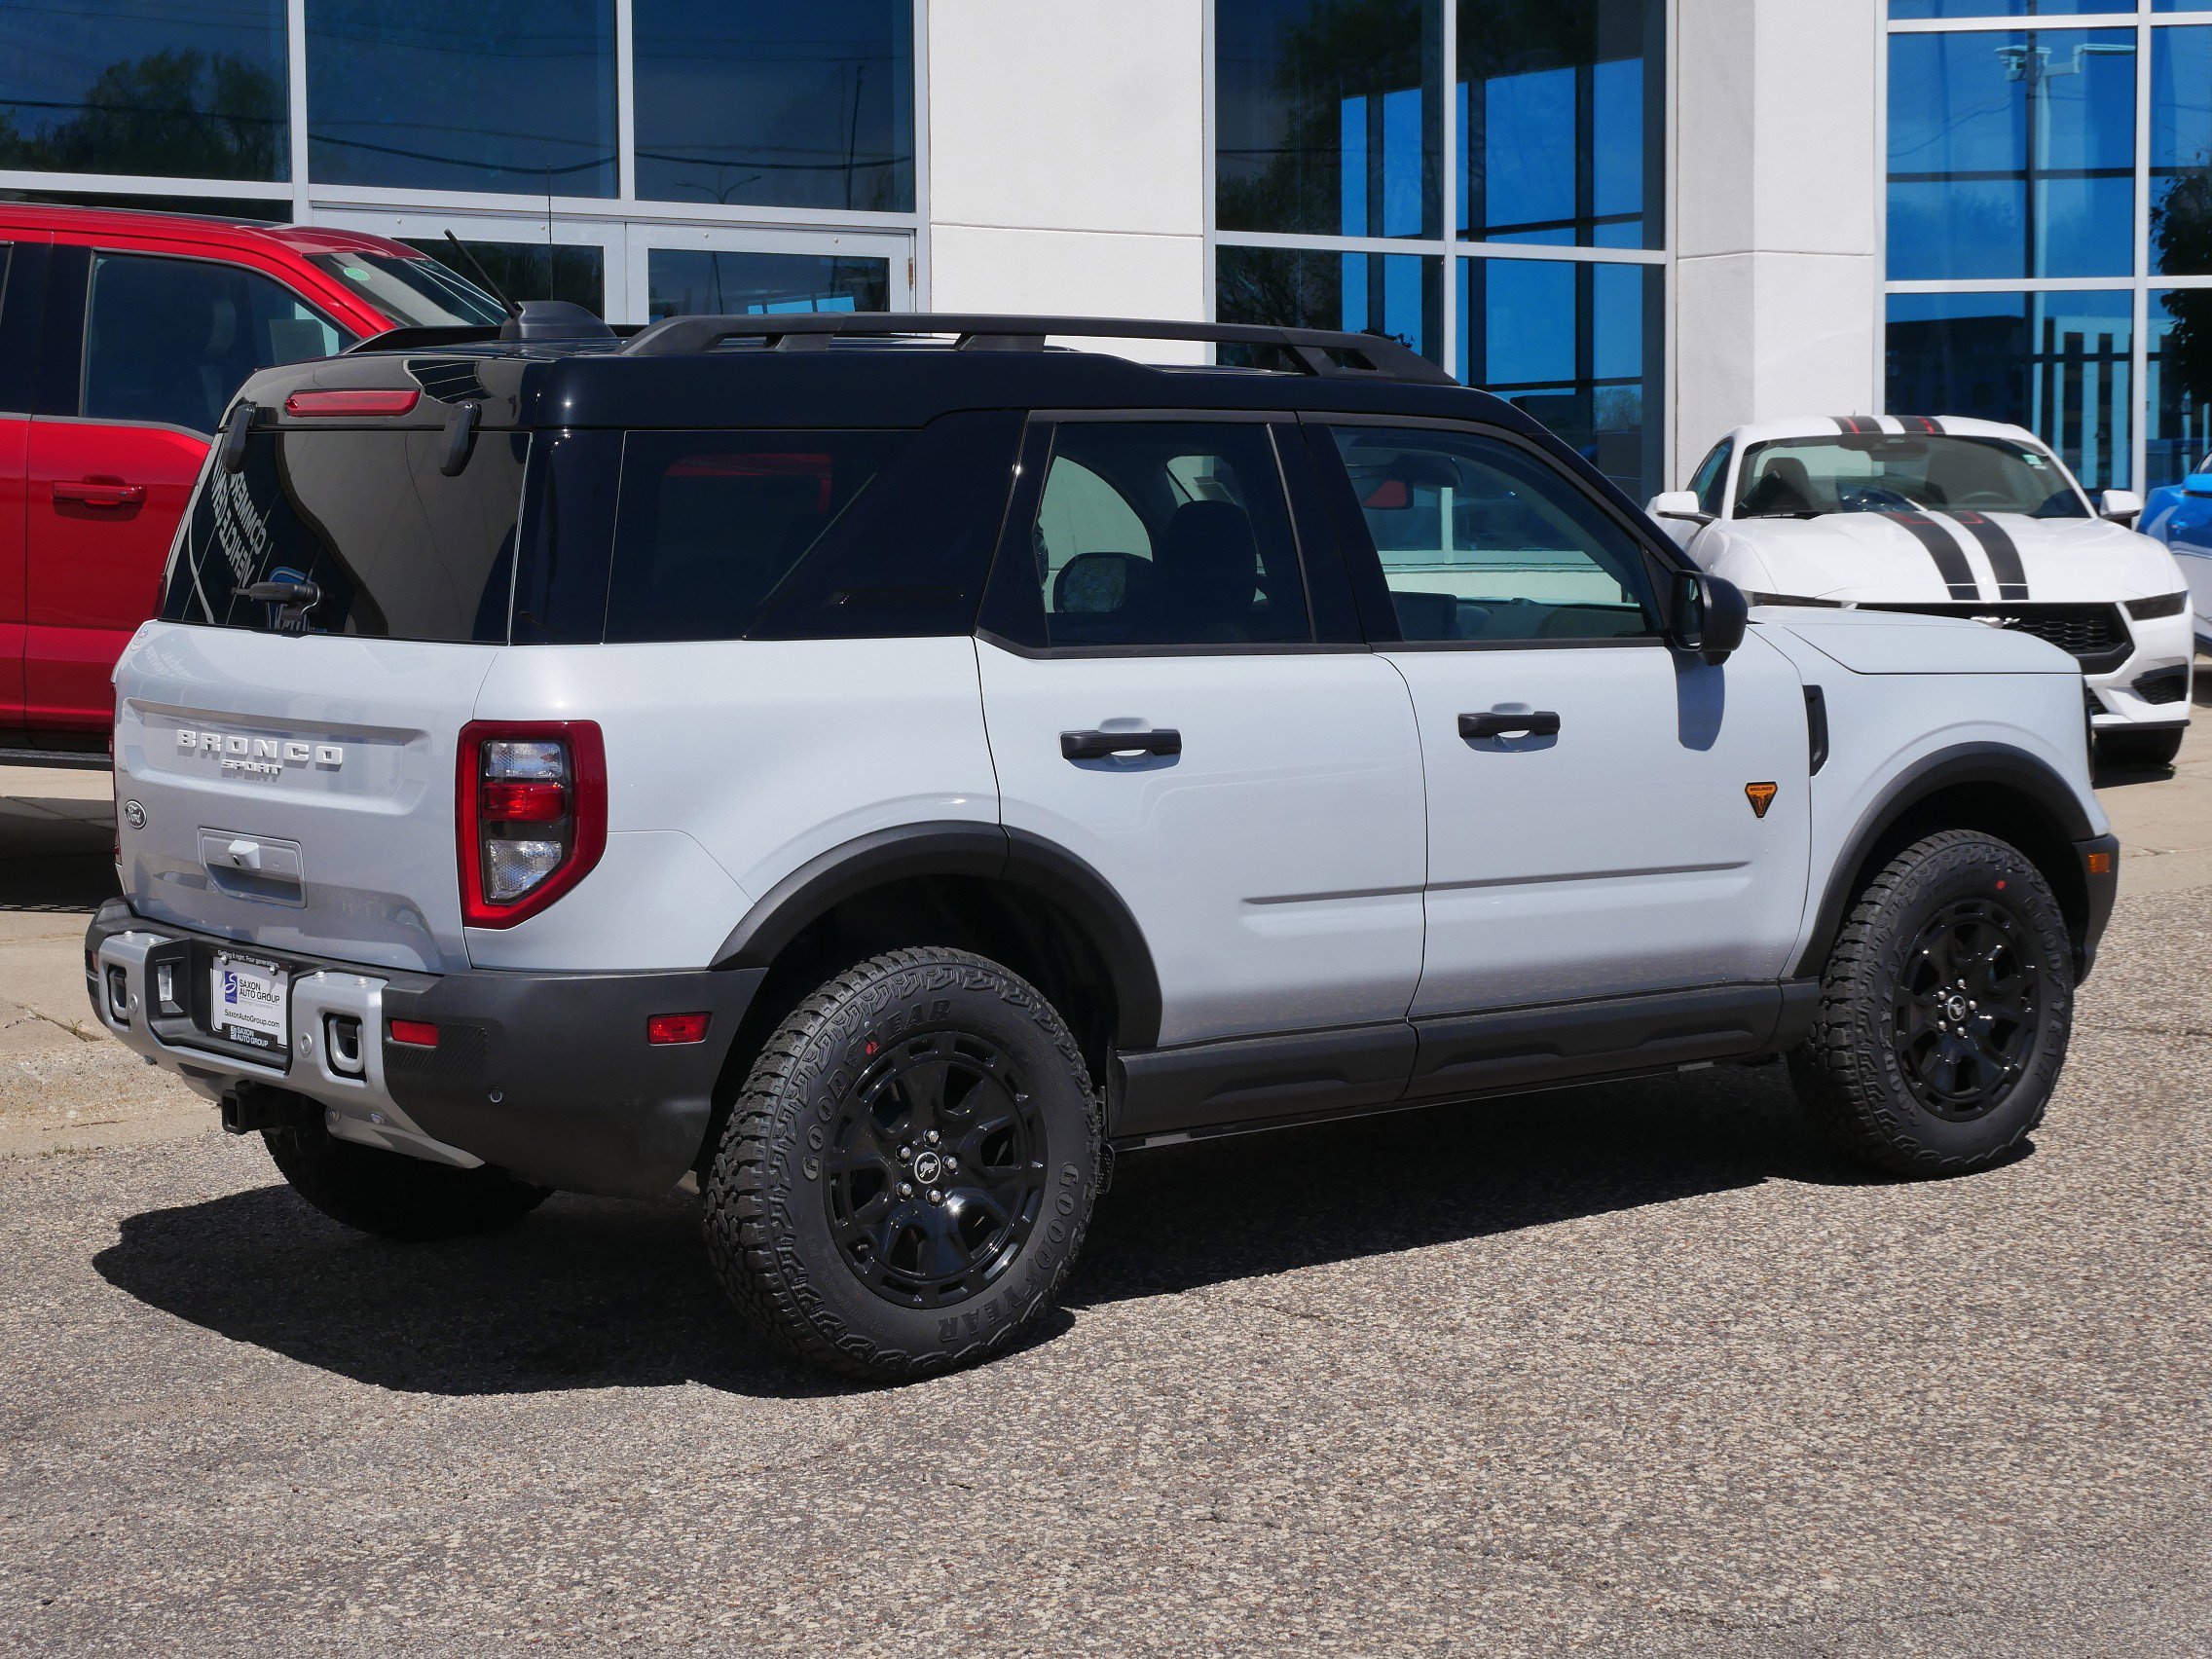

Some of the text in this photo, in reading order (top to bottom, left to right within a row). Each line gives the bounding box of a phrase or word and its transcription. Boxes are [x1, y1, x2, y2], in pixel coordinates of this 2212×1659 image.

[176, 729, 343, 765] BRONCO
[221, 758, 282, 775] SPORT
[239, 978, 261, 991] SAXON
[239, 989, 280, 1004] AUTO GROUP
[224, 1009, 280, 1028] SaxonAutoGroup.com
[237, 1025, 255, 1037] SAXON
[237, 1033, 269, 1048] AUTO GROUP
